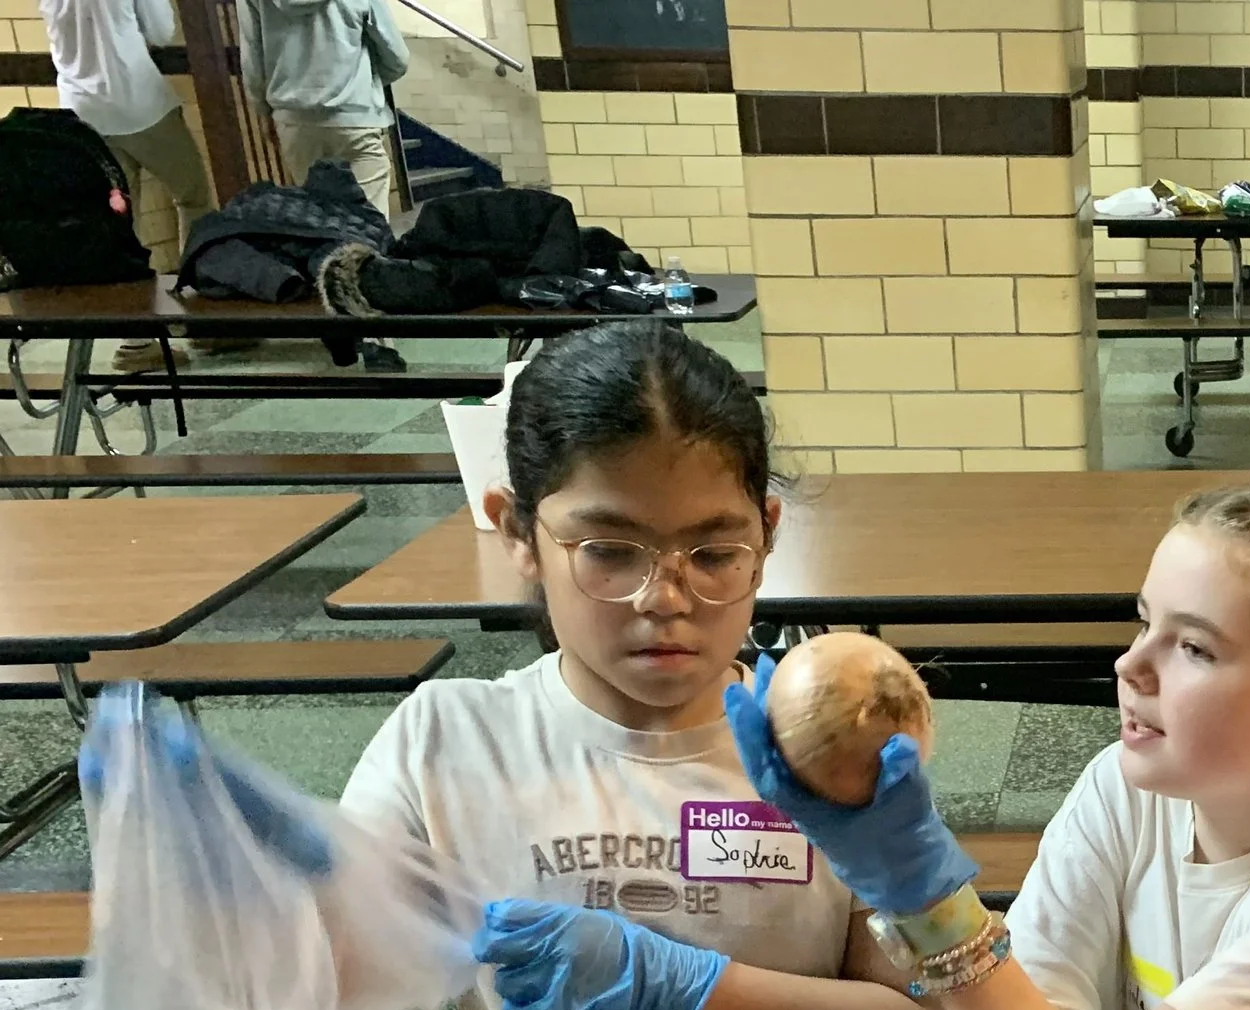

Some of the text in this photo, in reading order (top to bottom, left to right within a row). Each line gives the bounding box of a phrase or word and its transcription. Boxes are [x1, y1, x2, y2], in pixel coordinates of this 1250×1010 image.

[688, 807, 793, 830] Hello my name
[684, 884, 719, 915] 92
